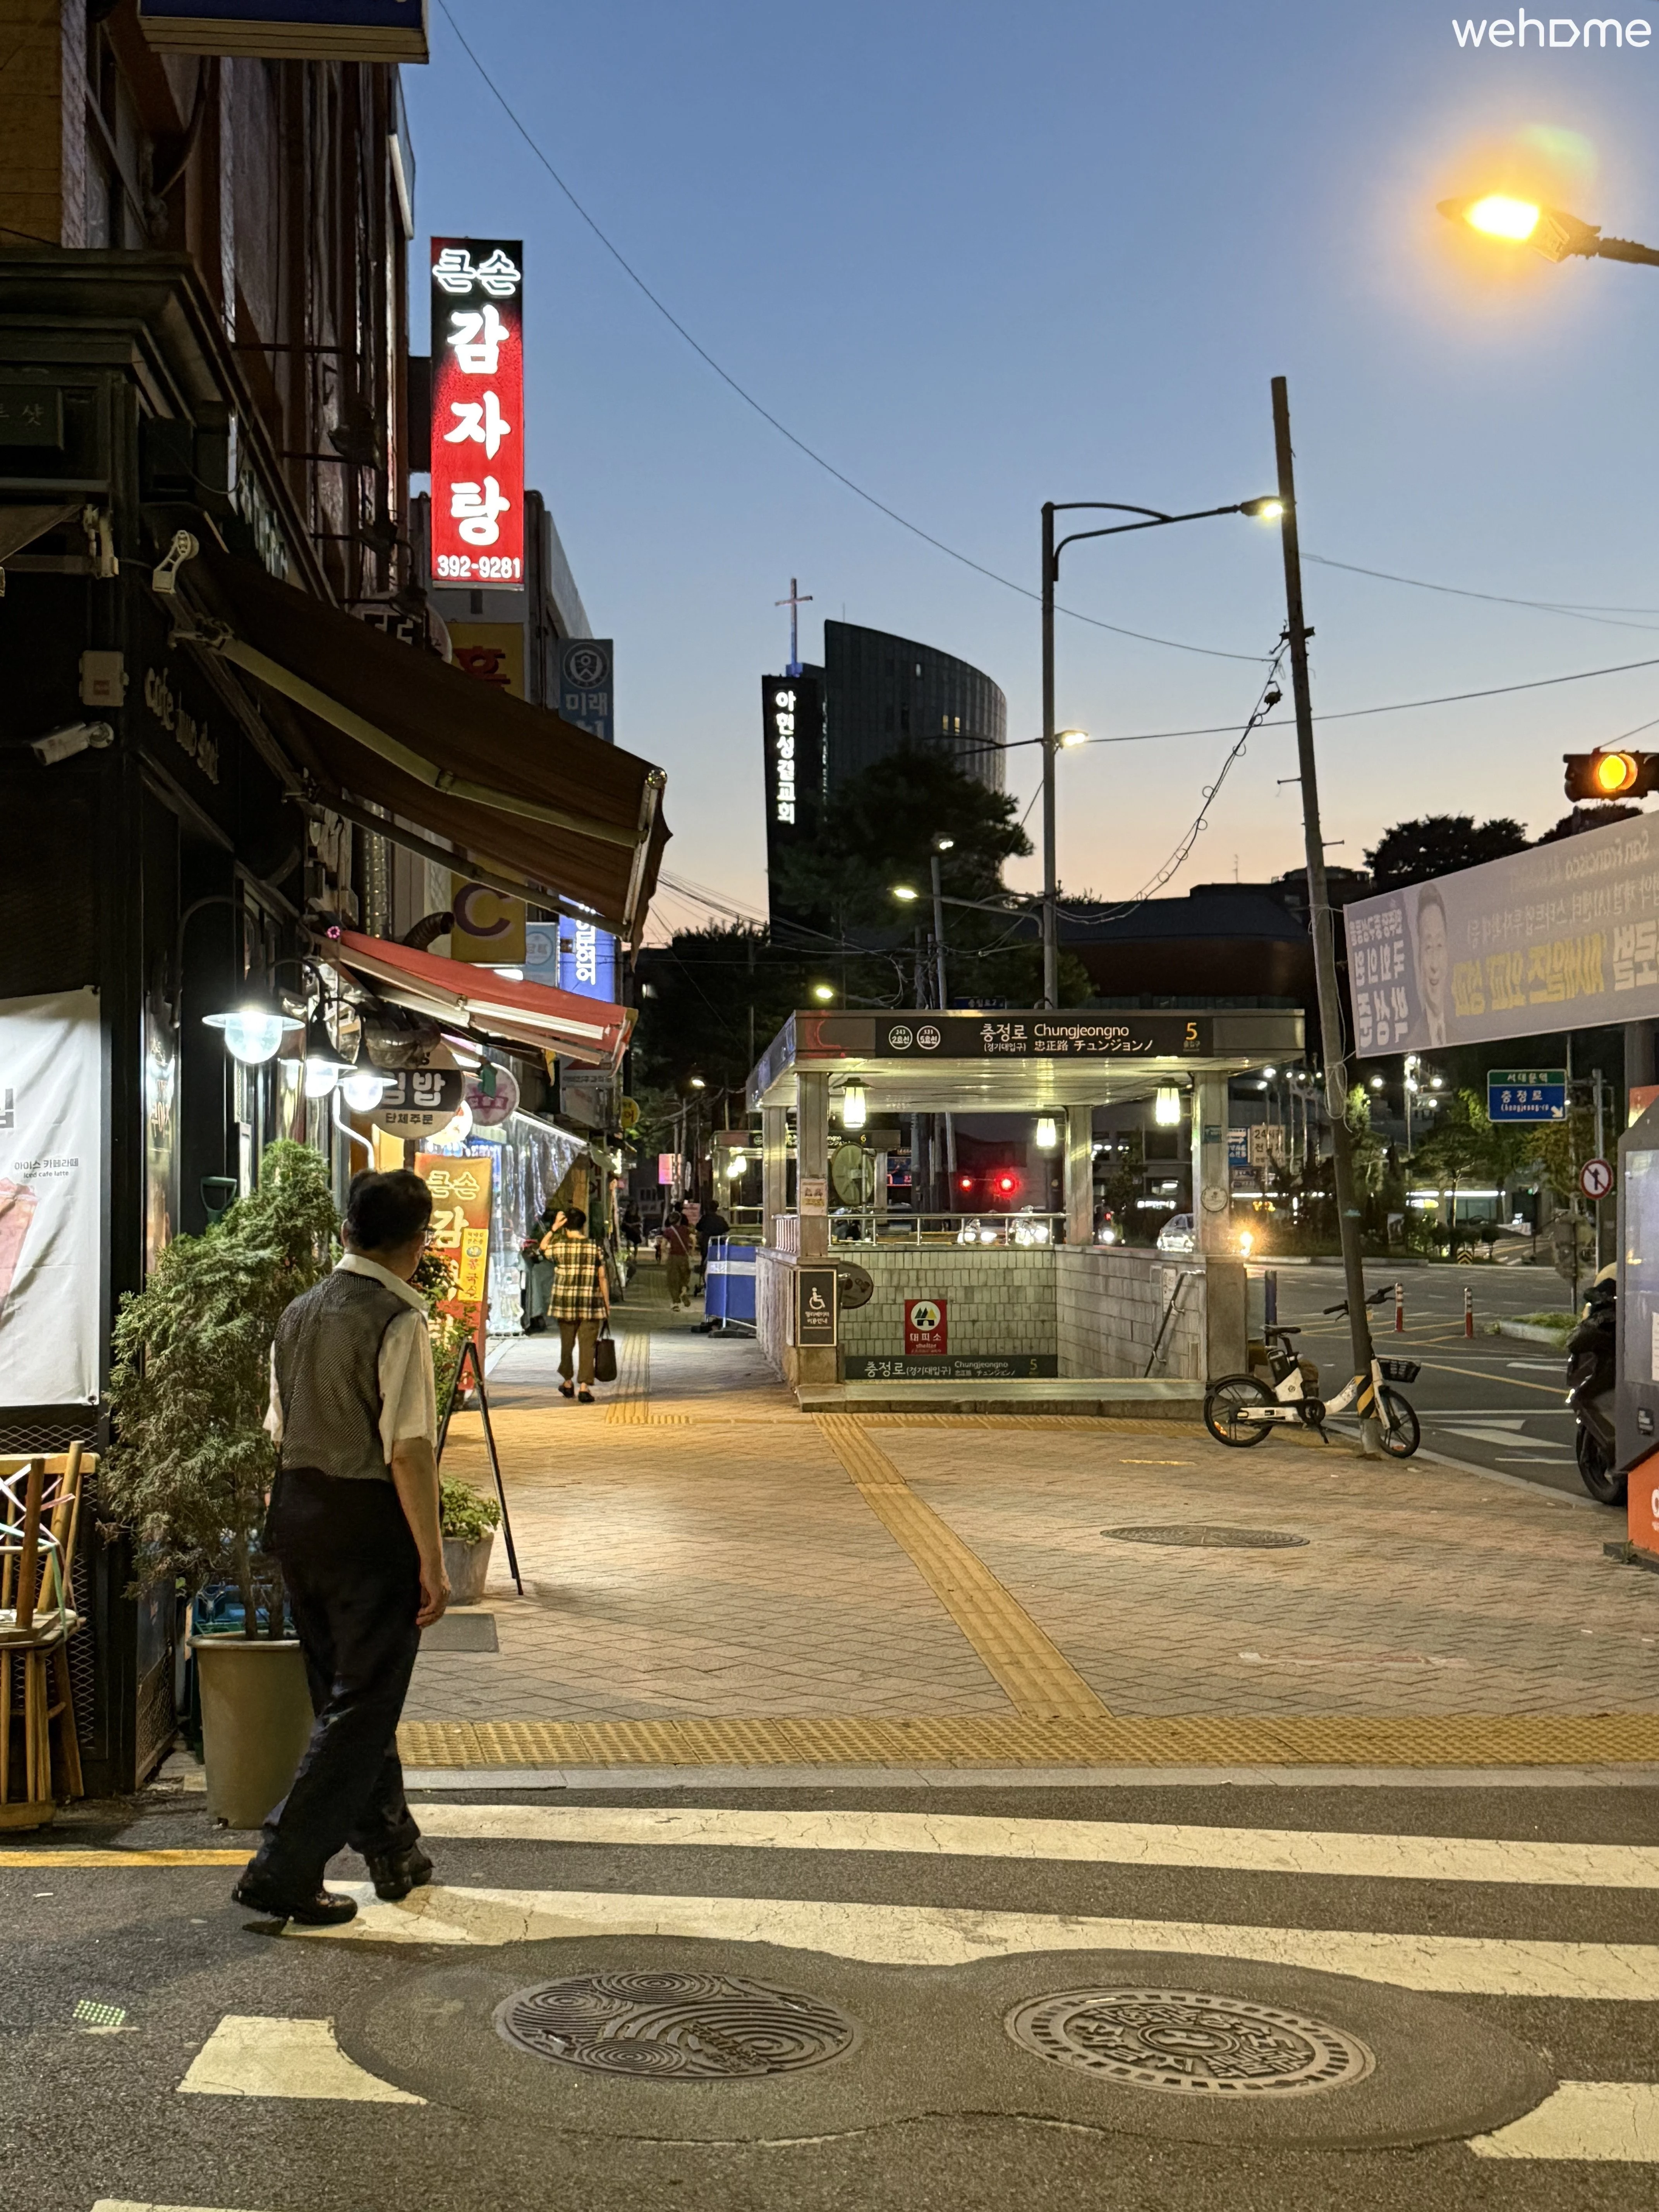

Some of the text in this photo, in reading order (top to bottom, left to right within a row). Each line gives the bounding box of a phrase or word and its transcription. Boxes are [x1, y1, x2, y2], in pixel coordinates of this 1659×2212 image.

[433, 249, 521, 296] 큰손
[444, 304, 511, 545] 감자탕
[437, 555, 520, 579] 392-9281
[566, 692, 607, 716] 미래
[775, 690, 796, 824] 아현성결교회
[980, 1024, 1129, 1042] 충정로 Chungjeongno
[1186, 1022, 1198, 1040] 5
[892, 1036, 909, 1044] 2호선
[920, 1036, 937, 1044] 5호선
[984, 1039, 1153, 1052] (경기대입구) 忠正路 チュンジョンノ
[1501, 1090, 1542, 1103] 충정로
[386, 1113, 433, 1124] 단체주문
[15, 1160, 41, 1170] 아이스
[426, 1170, 480, 1200] 큰손
[910, 1333, 941, 1341] 대피소
[864, 1361, 1008, 1377] 충정로 (경기대입구) Chungjeongno
[1030, 1359, 1038, 1370] 5
